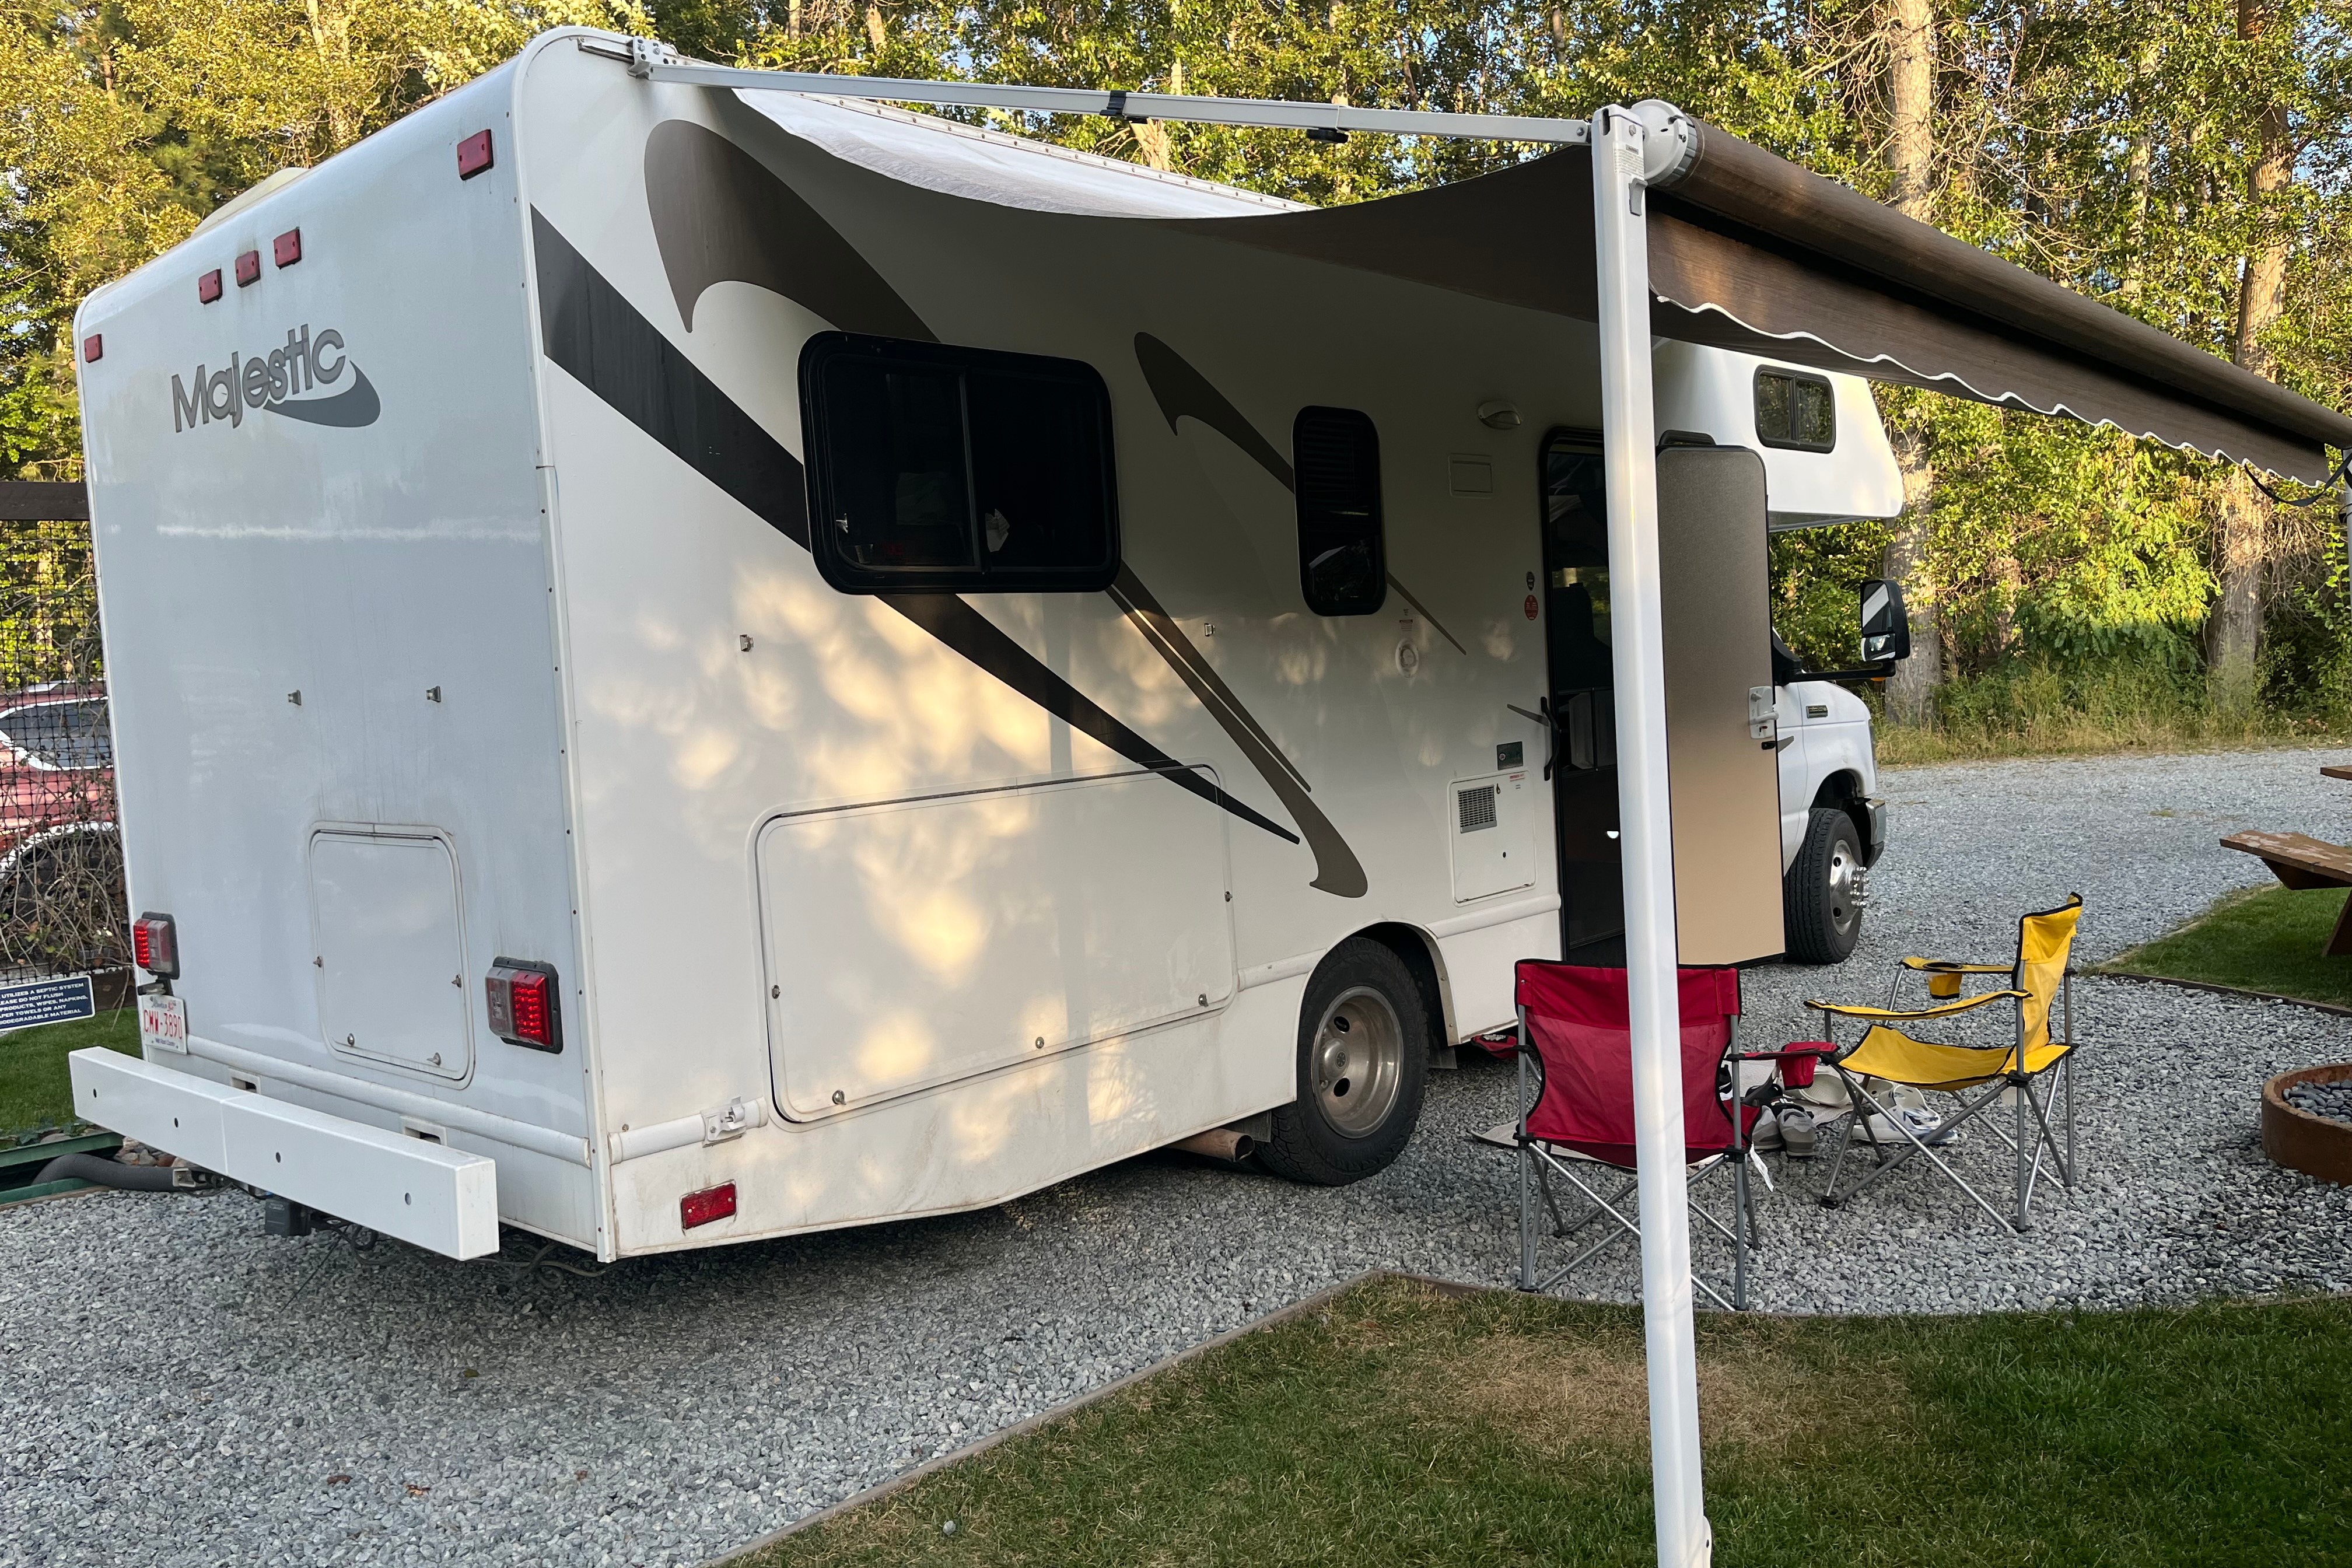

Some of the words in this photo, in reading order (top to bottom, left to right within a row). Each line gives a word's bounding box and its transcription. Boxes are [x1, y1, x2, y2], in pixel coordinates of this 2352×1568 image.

[172, 323, 346, 433] Majestic
[1, 991, 29, 999] UTILIZES
[59, 982, 84, 991] SYSTEM
[15, 1008, 42, 1016] TOWELS
[50, 1009, 82, 1017] MATERIAL
